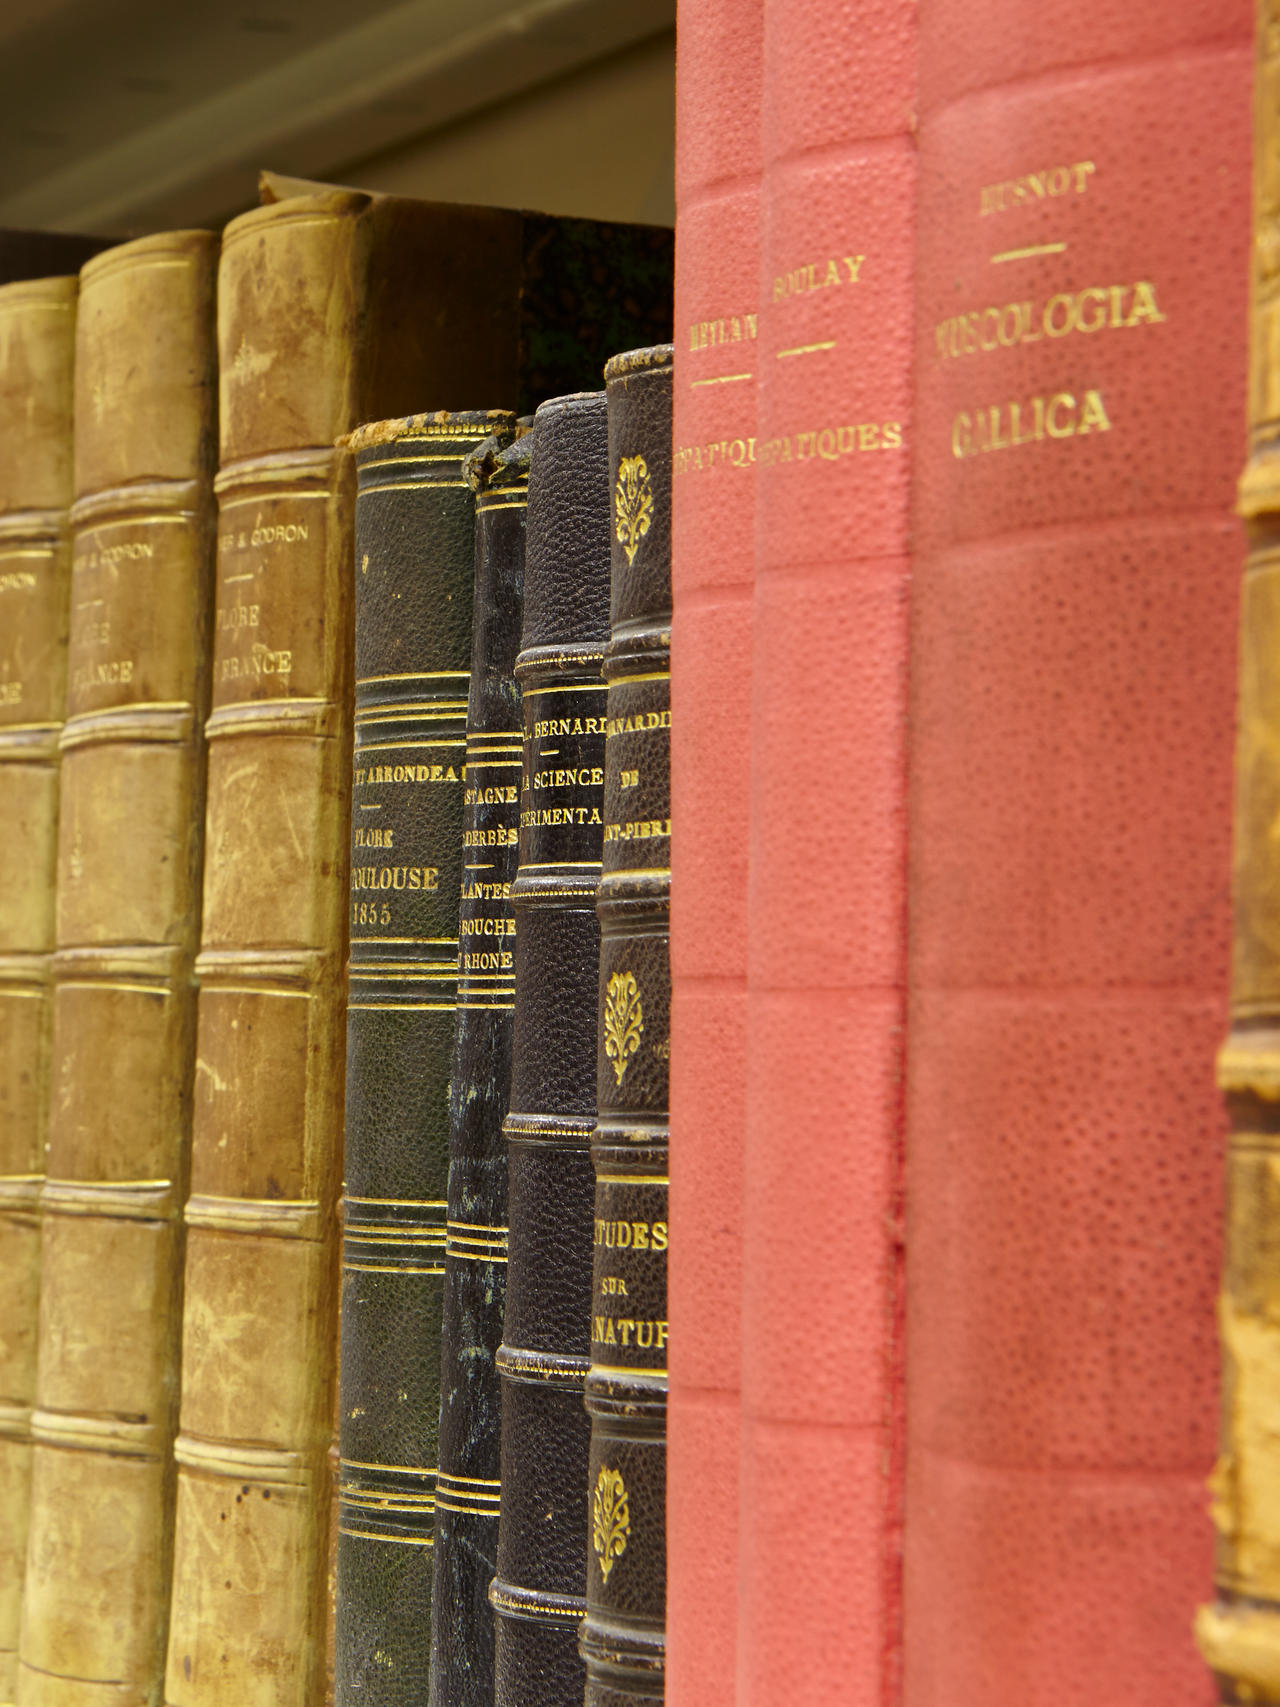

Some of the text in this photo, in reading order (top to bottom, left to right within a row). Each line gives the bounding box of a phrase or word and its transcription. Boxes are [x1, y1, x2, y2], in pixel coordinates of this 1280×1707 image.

[952, 389, 1111, 459] GALLICA
[533, 767, 604, 790] SCIENCE
[620, 769, 640, 789] DE
[354, 827, 394, 849] FLORE
[462, 823, 519, 847] DERBÈS
[352, 902, 391, 926] 1855
[464, 951, 513, 970] RHONE
[601, 1275, 629, 1296] SUR
